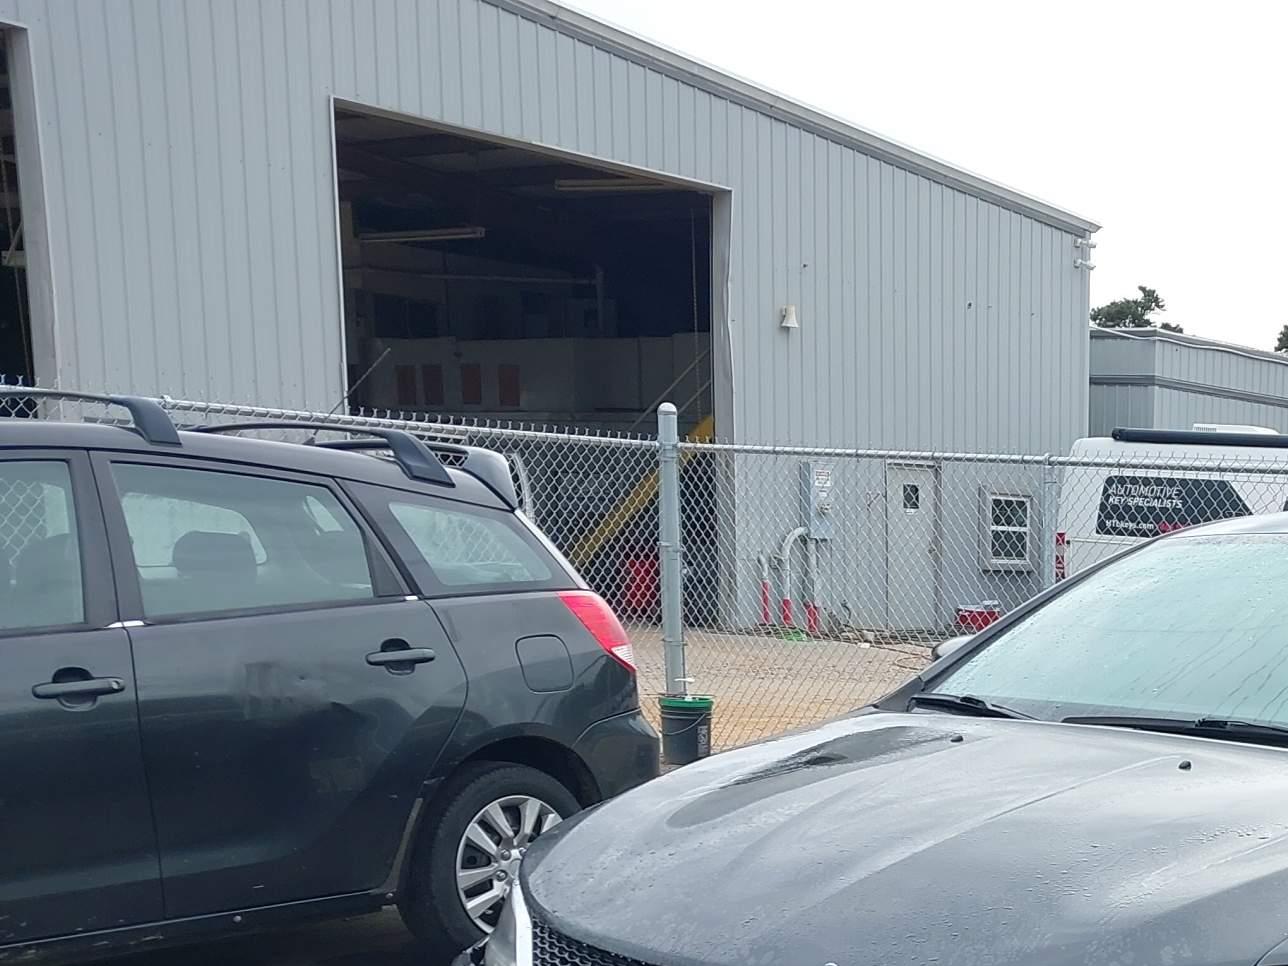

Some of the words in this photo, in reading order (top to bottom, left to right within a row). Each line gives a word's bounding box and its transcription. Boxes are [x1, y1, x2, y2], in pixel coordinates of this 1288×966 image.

[1108, 484, 1182, 498] AUTOMOTIVE
[1108, 496, 1126, 506] KEY
[1127, 497, 1183, 509] SPECIALISTS
